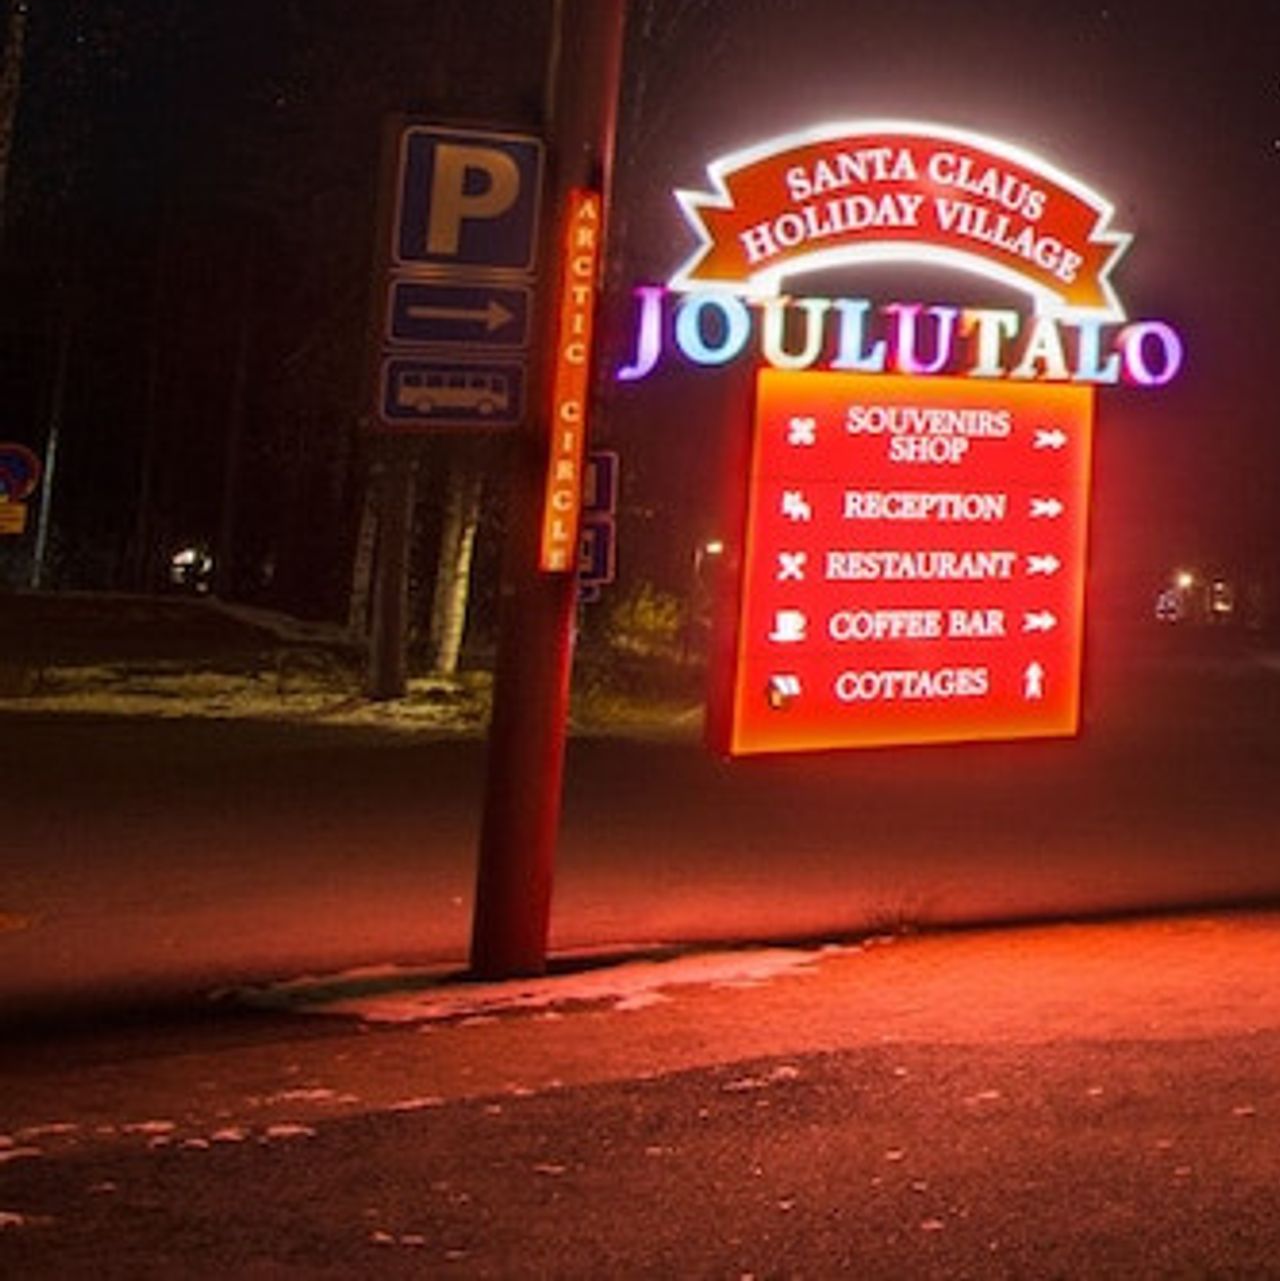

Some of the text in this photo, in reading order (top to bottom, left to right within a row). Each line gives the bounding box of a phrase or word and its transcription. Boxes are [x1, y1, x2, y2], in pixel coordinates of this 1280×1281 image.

[427, 143, 521, 255] P
[786, 147, 1047, 222] SANTA CLAUS
[739, 193, 1084, 285] HOLIDAY VILLAGE
[616, 284, 1183, 387] JOULUTALO
[548, 199, 597, 571] ARCTIC CIRCLE
[845, 405, 1011, 438] SOUVENIRS
[889, 437, 969, 464] SHOP
[844, 491, 1007, 521] RECEPTION
[825, 551, 1017, 580] RESTAURANT
[829, 609, 1006, 640] COFFEE BAR
[835, 667, 990, 701] COTTAGES
